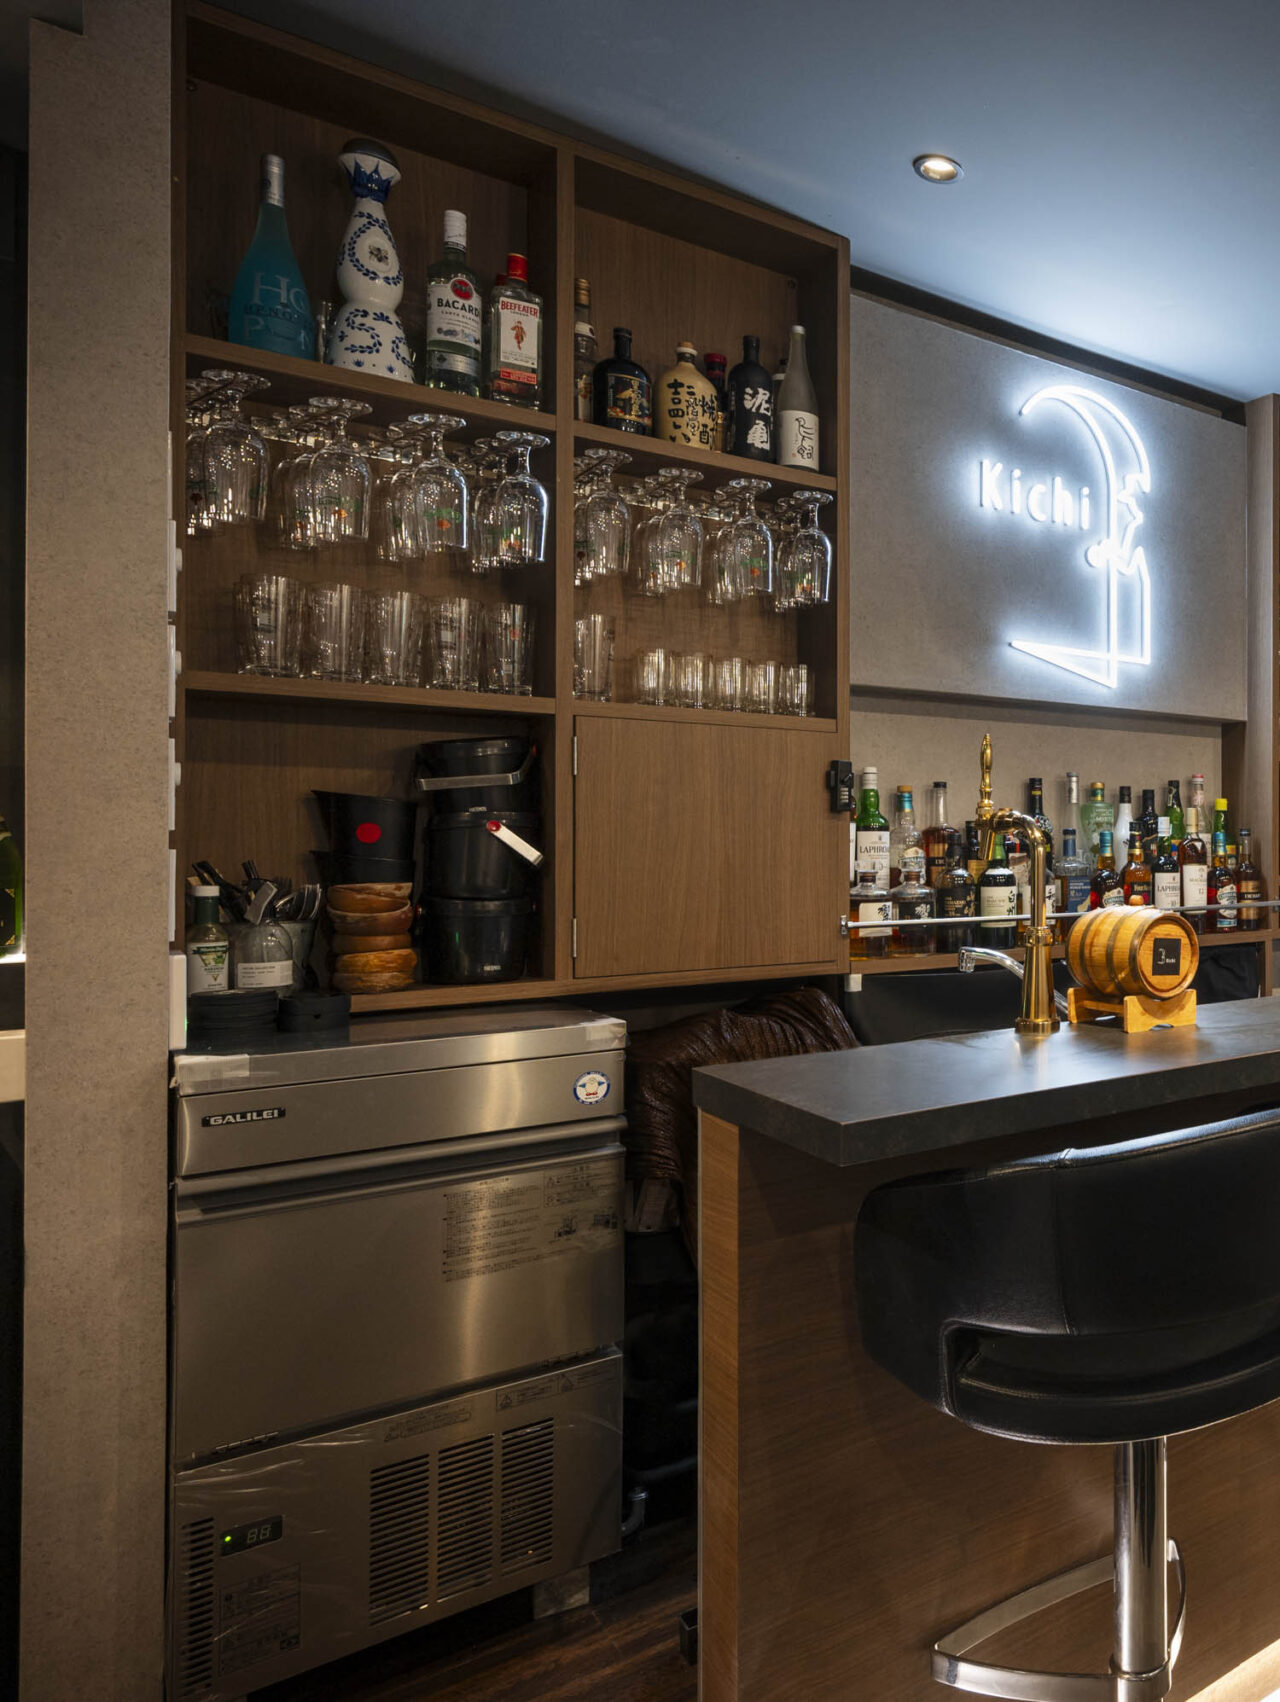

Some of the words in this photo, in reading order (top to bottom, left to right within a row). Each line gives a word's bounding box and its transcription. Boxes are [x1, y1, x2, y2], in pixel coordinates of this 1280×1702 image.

[437, 297, 480, 318] BACARD
[501, 300, 539, 318] BEEFEATER
[980, 459, 1090, 531] Kichi
[210, 1109, 279, 1125] GALILEI
